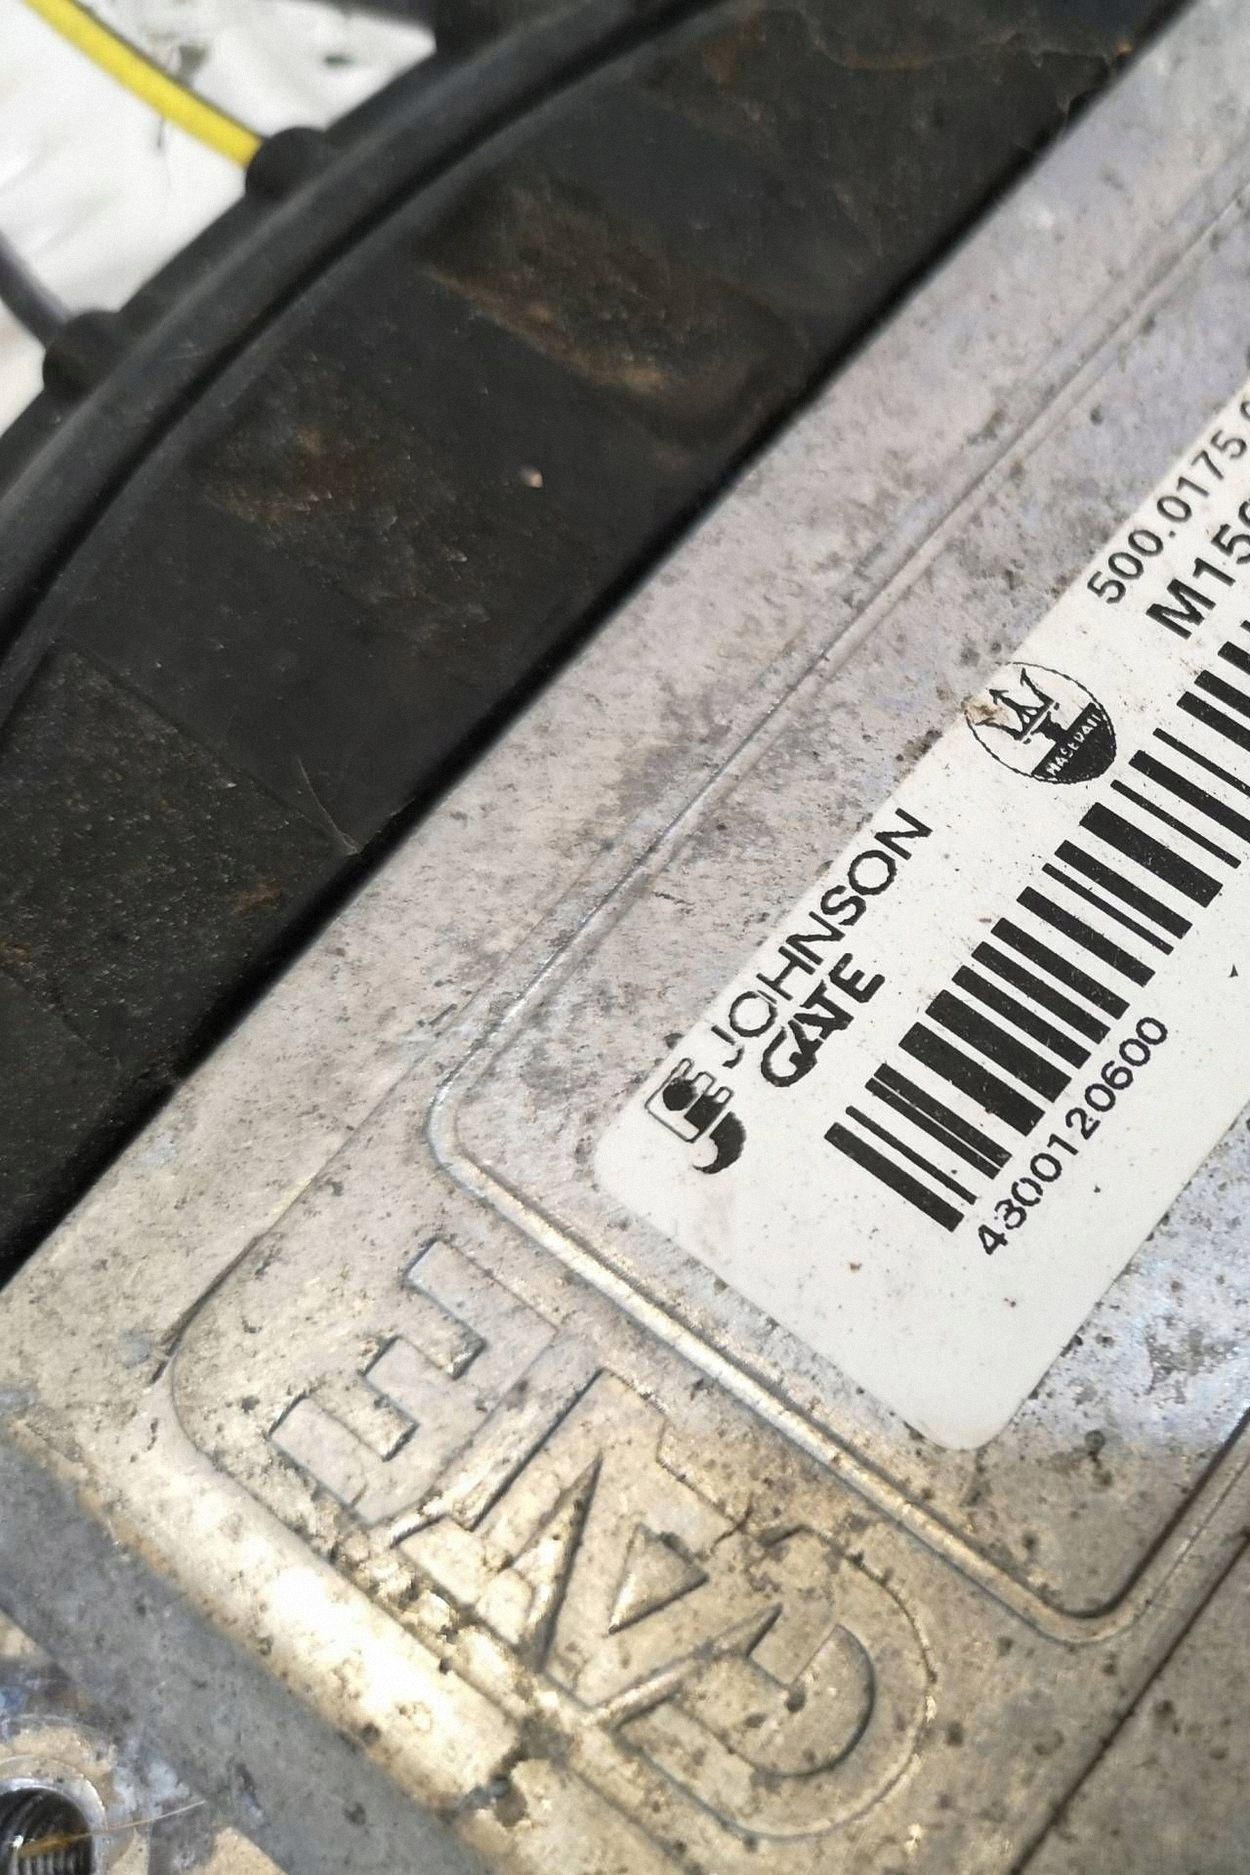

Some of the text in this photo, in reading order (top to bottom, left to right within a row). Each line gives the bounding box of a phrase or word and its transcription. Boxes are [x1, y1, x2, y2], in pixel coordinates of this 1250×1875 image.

[710, 808, 934, 1069] JOHNSON
[760, 952, 886, 1088] GATE
[977, 1016, 1169, 1256] 4300120600
[269, 1237, 935, 1840] GATE
